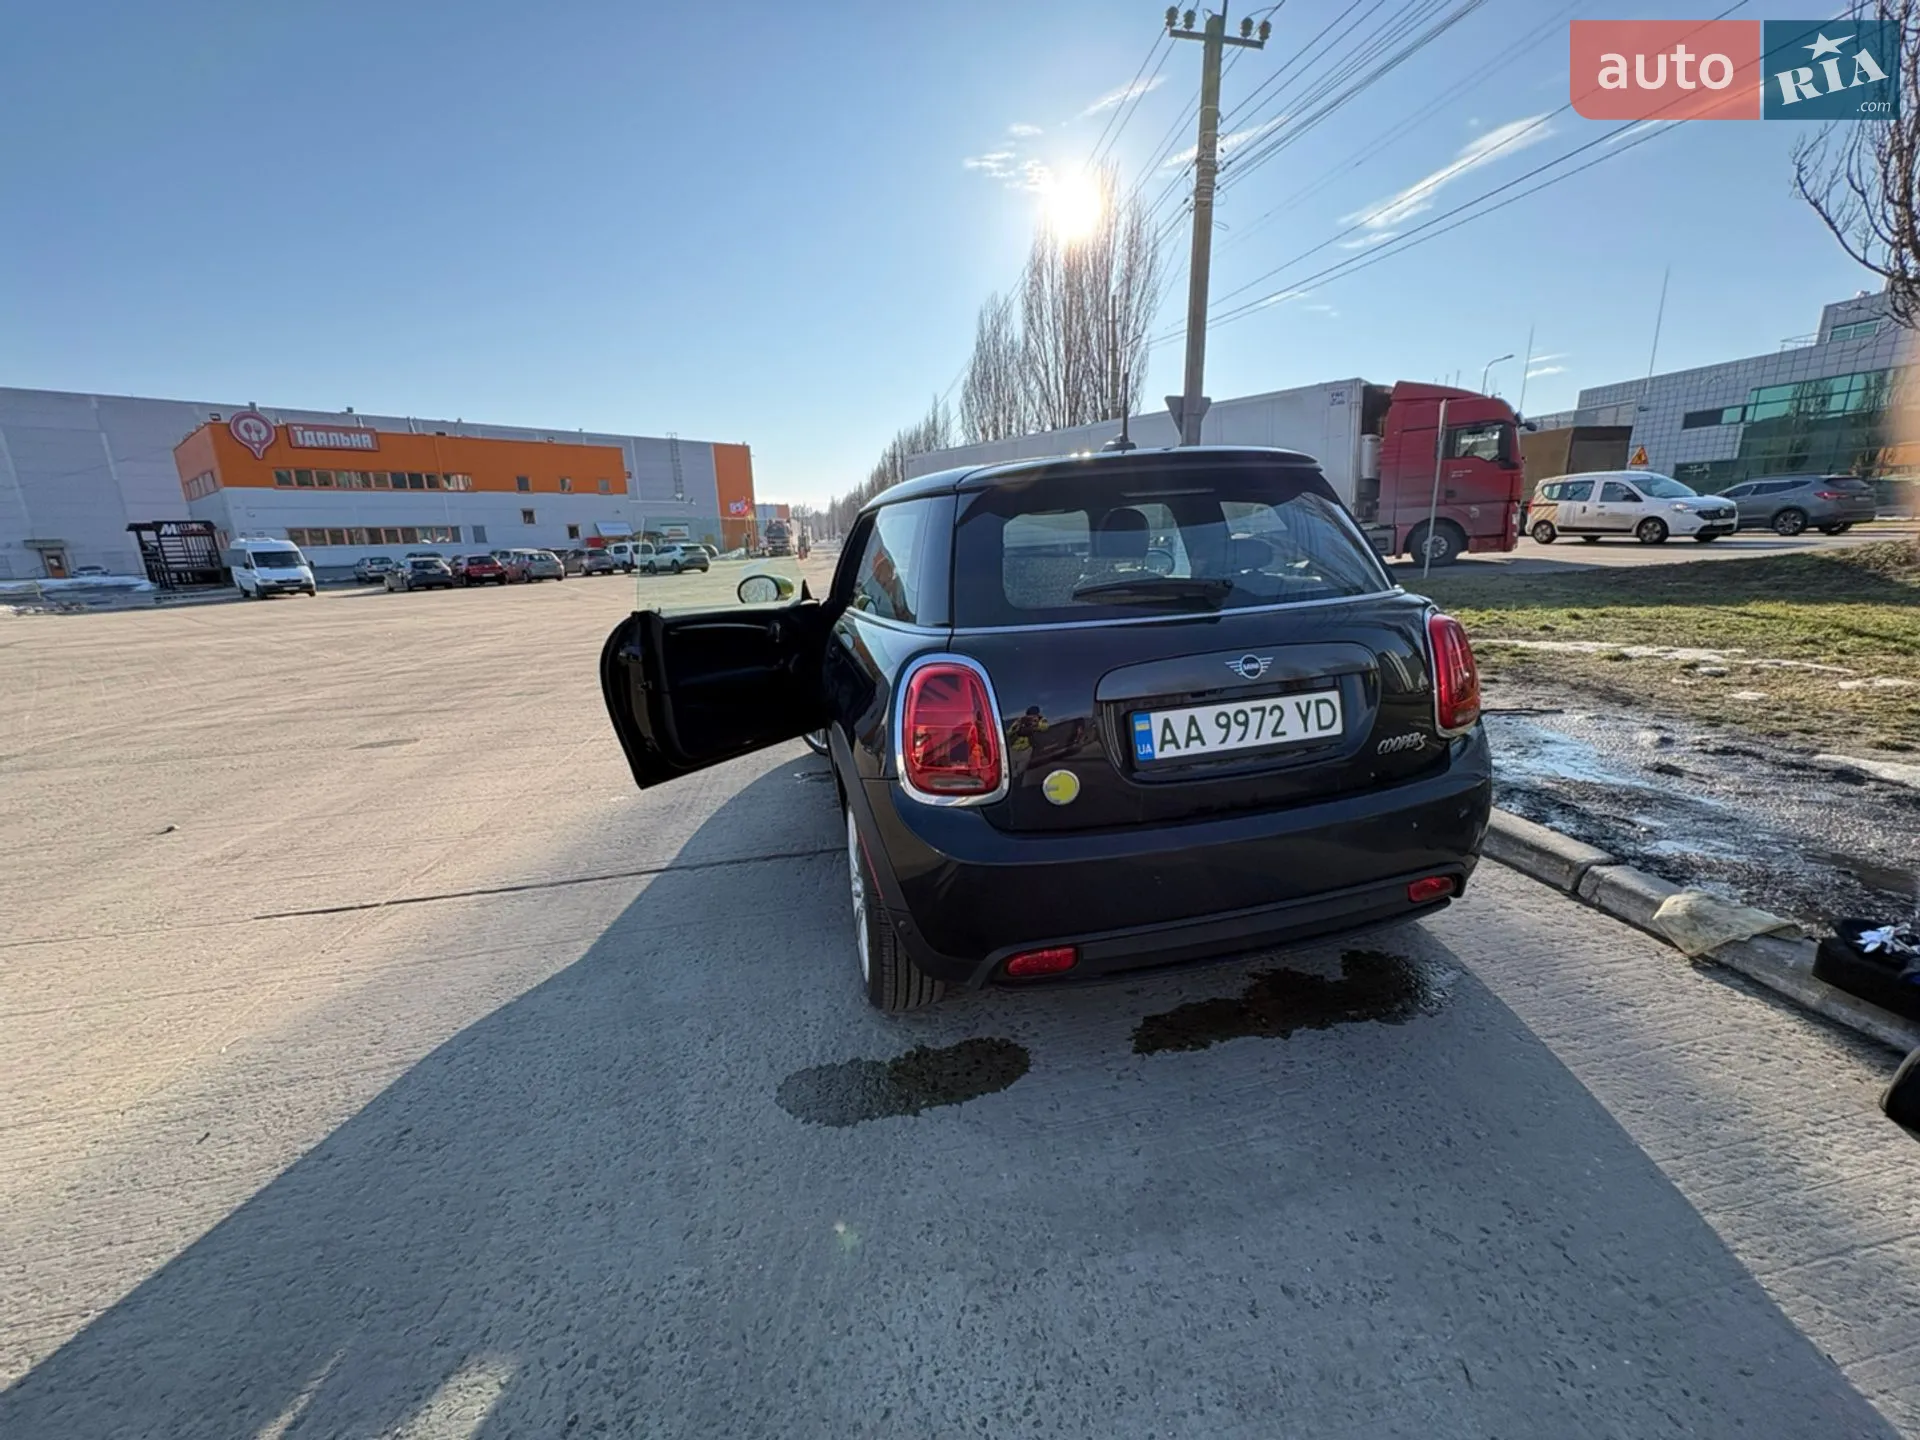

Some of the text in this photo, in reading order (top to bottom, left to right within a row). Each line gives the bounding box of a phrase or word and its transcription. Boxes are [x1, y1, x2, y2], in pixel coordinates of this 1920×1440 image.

[1158, 698, 1338, 753] AA 9972 YD
[1137, 743, 1153, 755] UA
